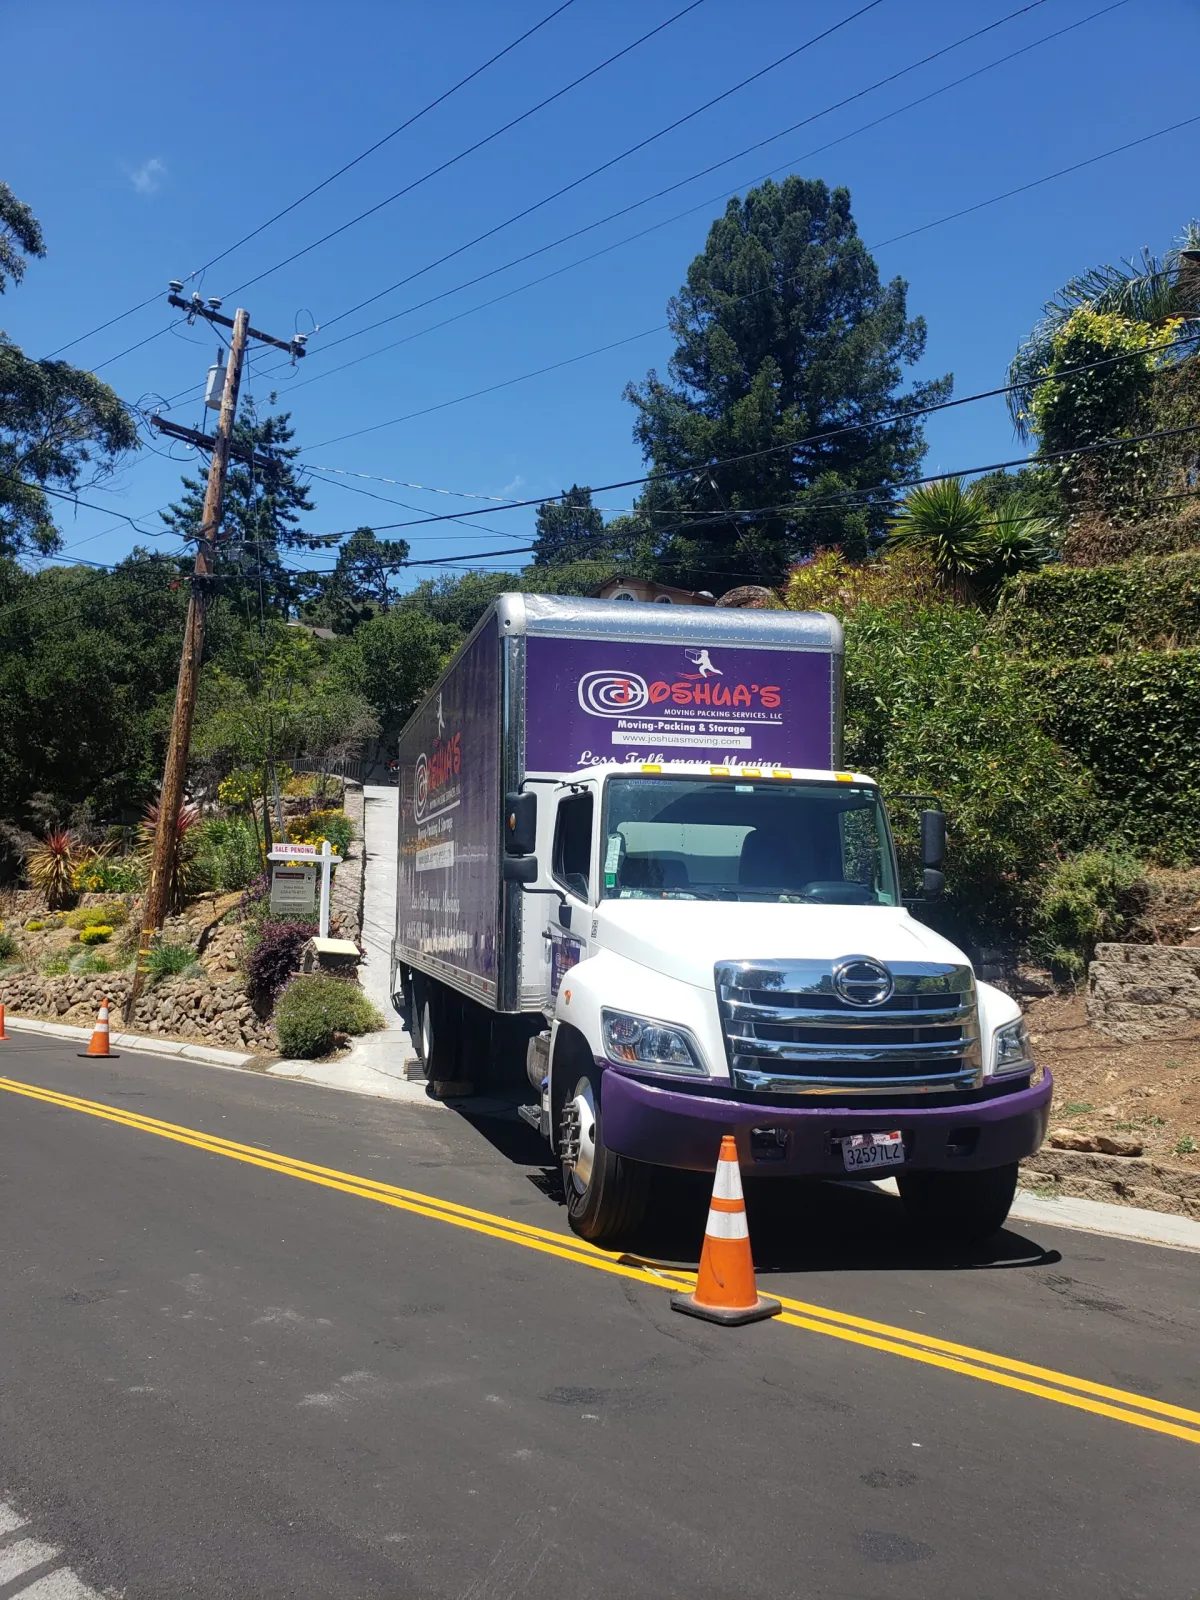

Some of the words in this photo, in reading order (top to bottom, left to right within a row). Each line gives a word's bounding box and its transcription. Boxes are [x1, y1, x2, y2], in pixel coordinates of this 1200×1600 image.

[614, 680, 781, 708] JOSHUA'S
[697, 710, 730, 718] PACKING
[617, 720, 696, 732] Moving-Packing
[698, 723, 706, 732] &
[708, 724, 746, 734] Storage
[622, 734, 741, 746] www.joshuasmoving.com
[577, 751, 616, 765] Less
[847, 1143, 900, 1166] 32597L2
